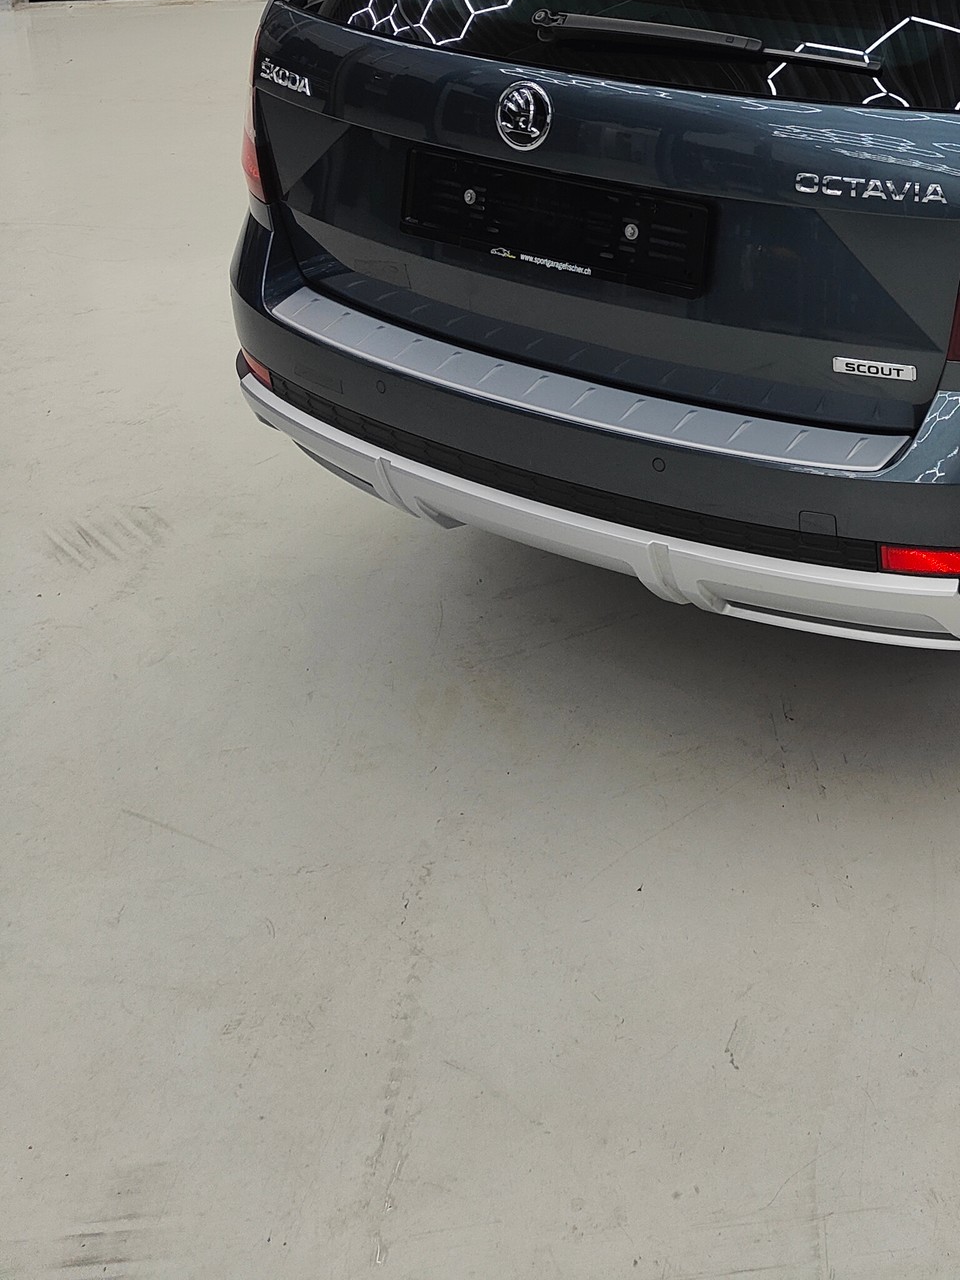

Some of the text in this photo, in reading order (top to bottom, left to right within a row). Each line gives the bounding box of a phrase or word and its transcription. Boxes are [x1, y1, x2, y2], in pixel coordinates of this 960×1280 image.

[260, 57, 311, 96] ŠKODA
[795, 172, 948, 204] OCTAVIA
[520, 253, 592, 275] www.sportgaragefischer.ch
[845, 362, 904, 377] SCOUT
